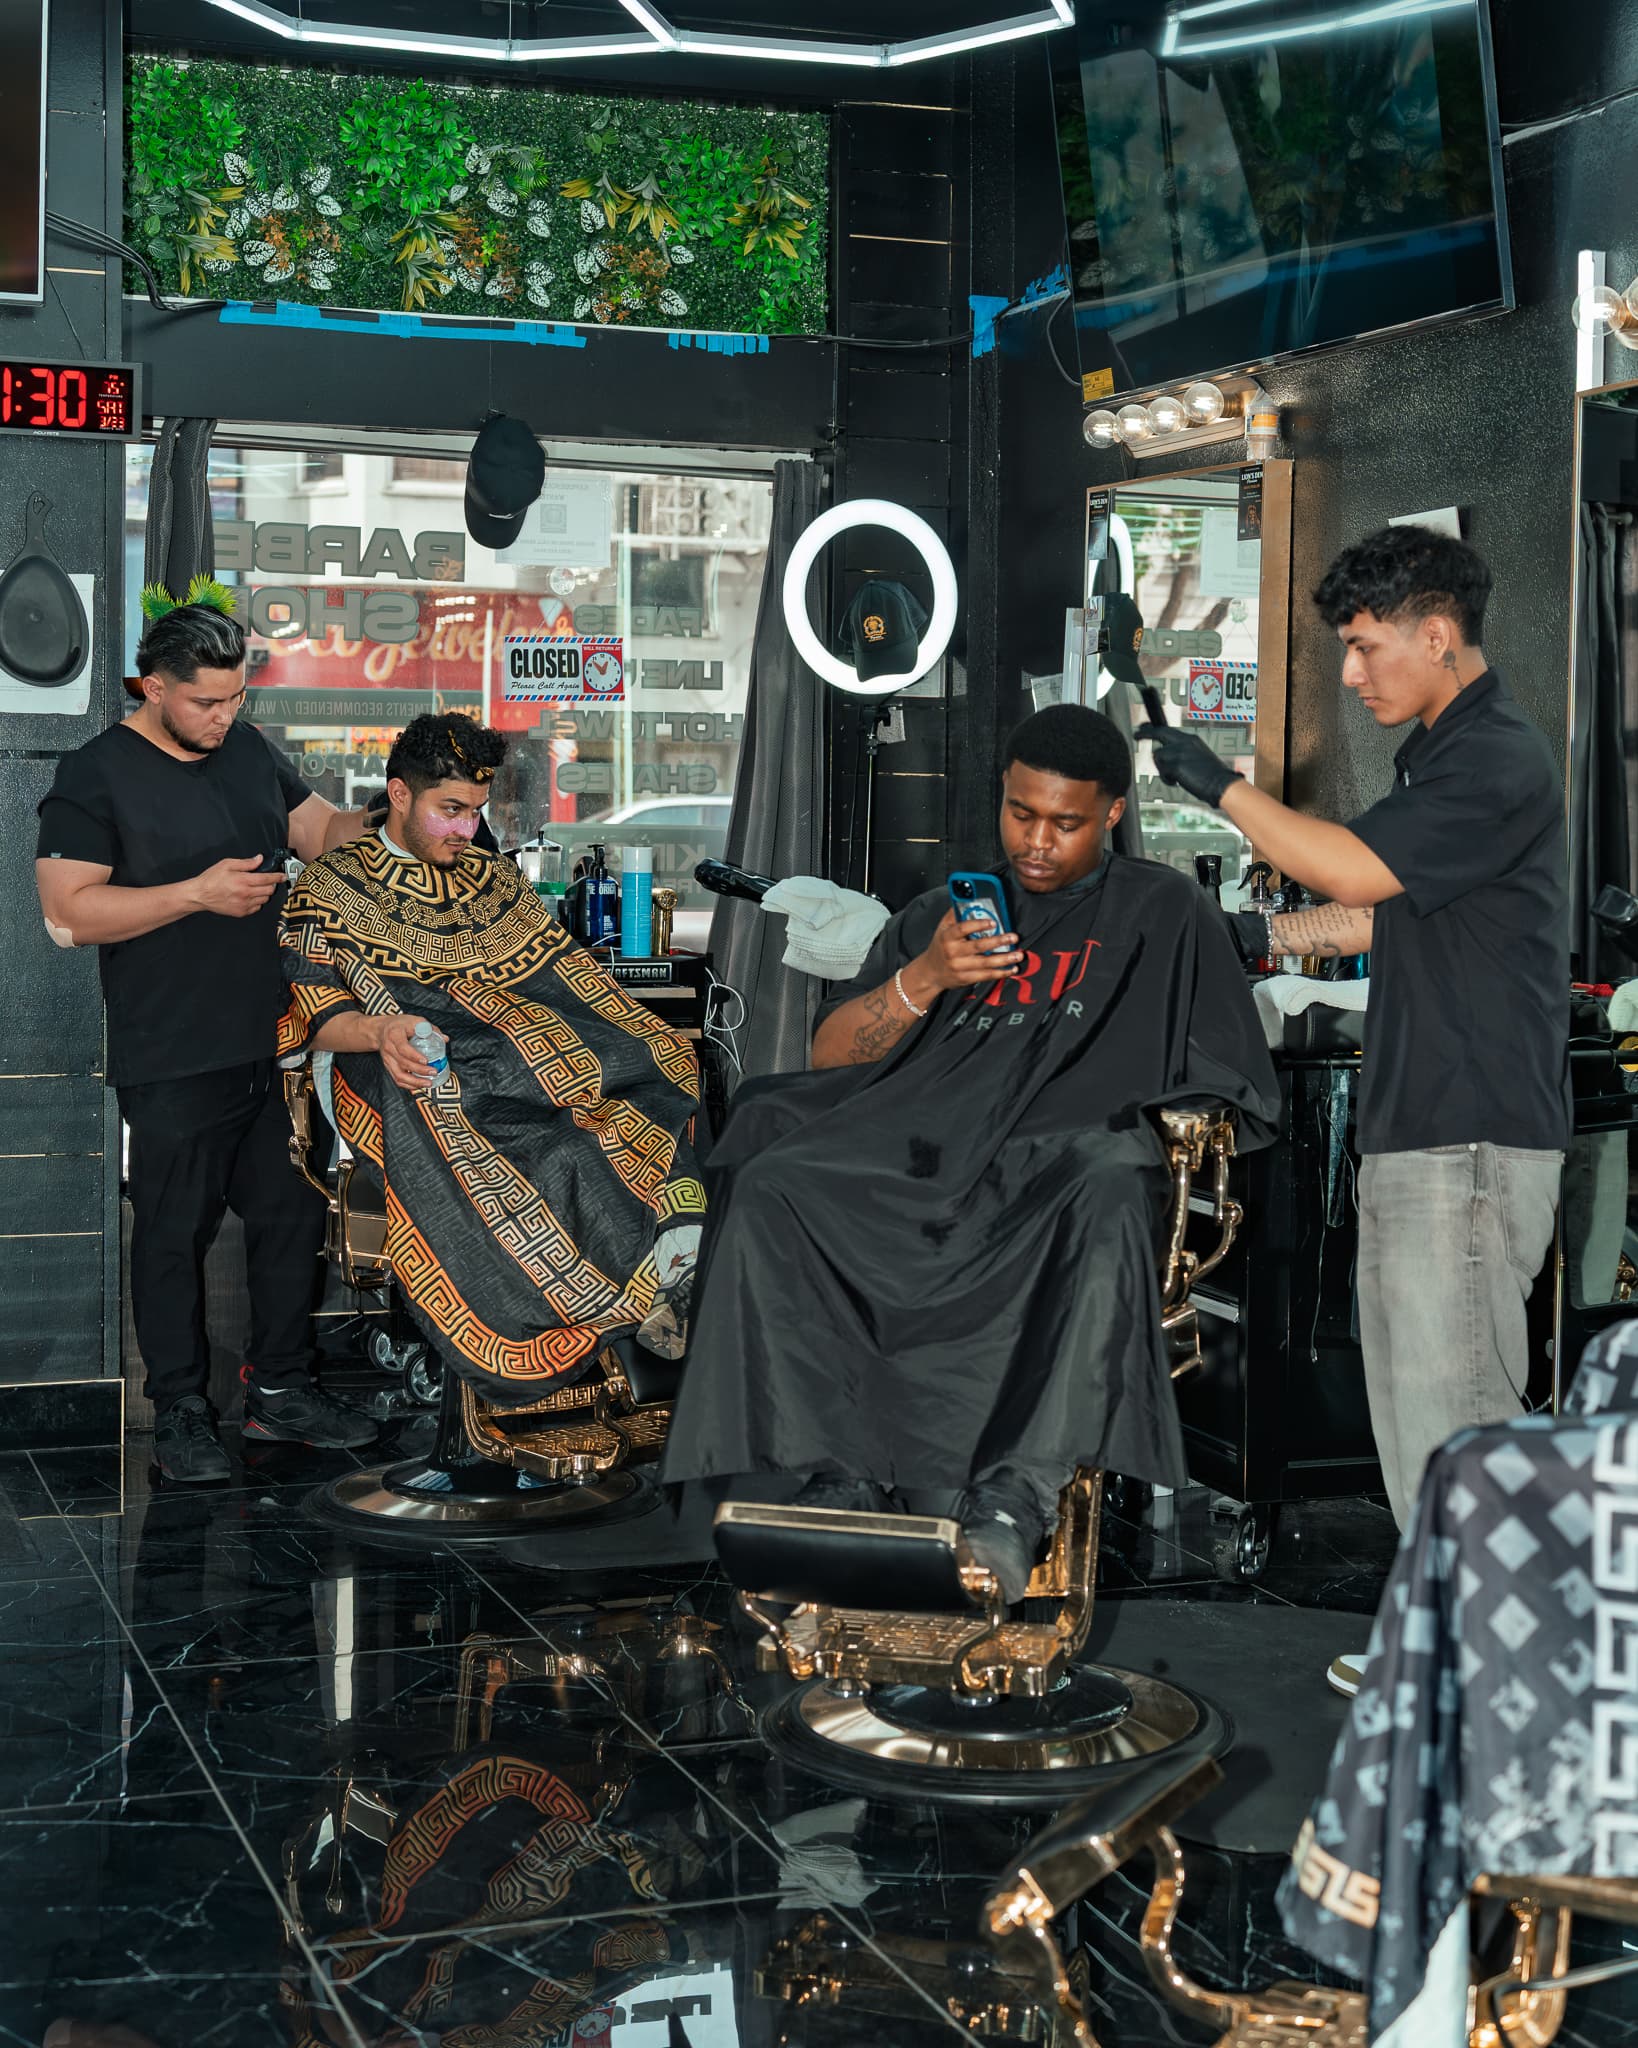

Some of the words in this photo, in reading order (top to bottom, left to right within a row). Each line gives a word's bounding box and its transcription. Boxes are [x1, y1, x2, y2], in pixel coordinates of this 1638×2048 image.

[2, 367, 88, 428] 1:30
[96, 400, 125, 414] SAT
[1142, 628, 1222, 658] ADES
[510, 648, 580, 679] CLOSED
[511, 681, 535, 690] Please
[537, 681, 555, 690] Call
[558, 681, 580, 691] Again
[966, 939, 1102, 1007] RU
